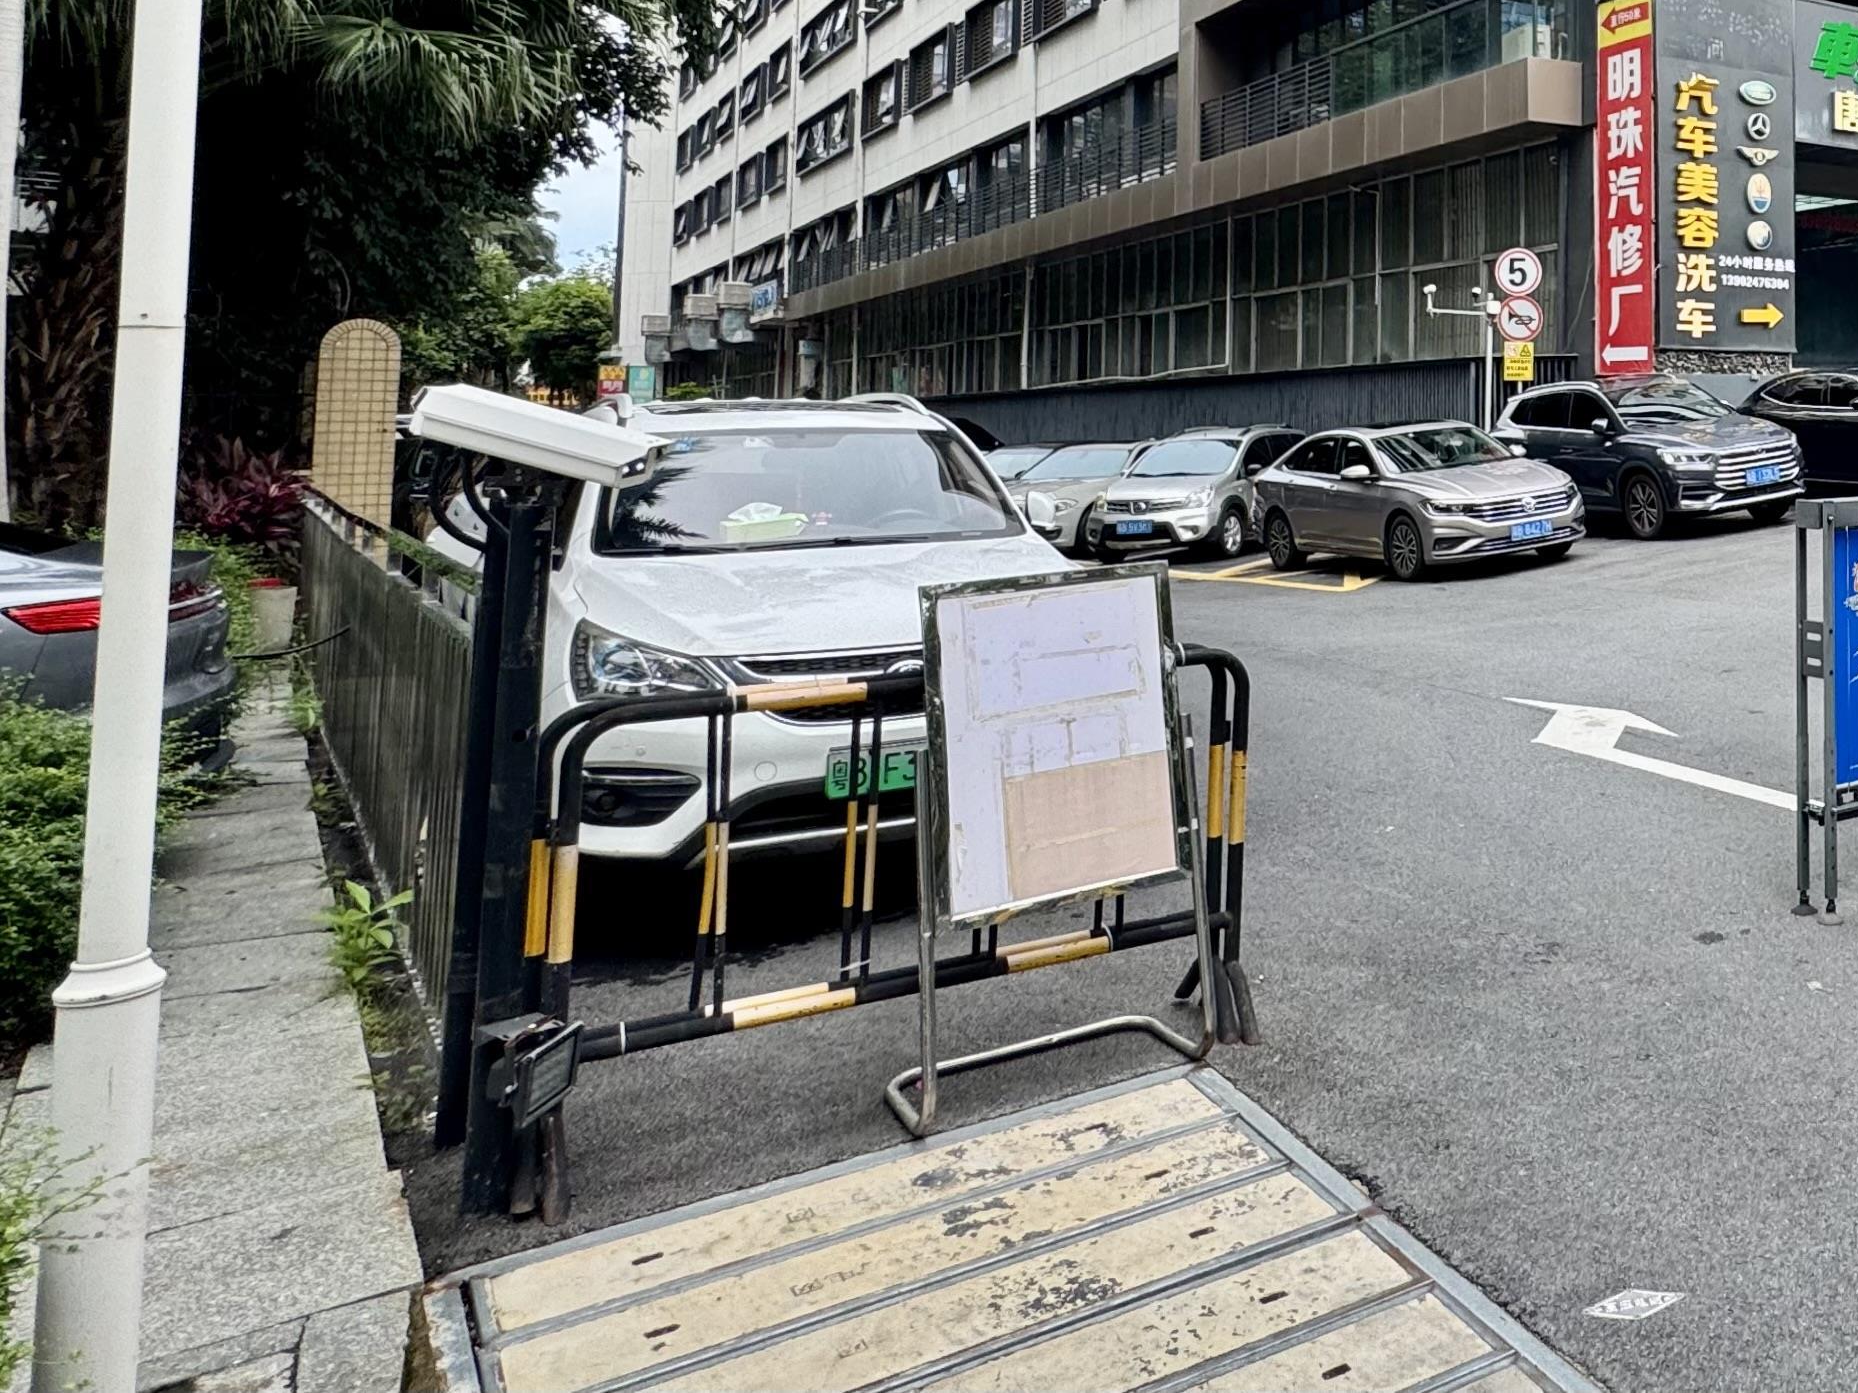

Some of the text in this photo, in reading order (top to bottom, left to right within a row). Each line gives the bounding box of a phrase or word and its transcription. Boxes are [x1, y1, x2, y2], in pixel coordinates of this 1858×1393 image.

[1509, 258, 1527, 286] 5
[1607, 48, 1643, 337] 明珠汽修厂
[1676, 71, 1720, 338] 汽车美容洗车
